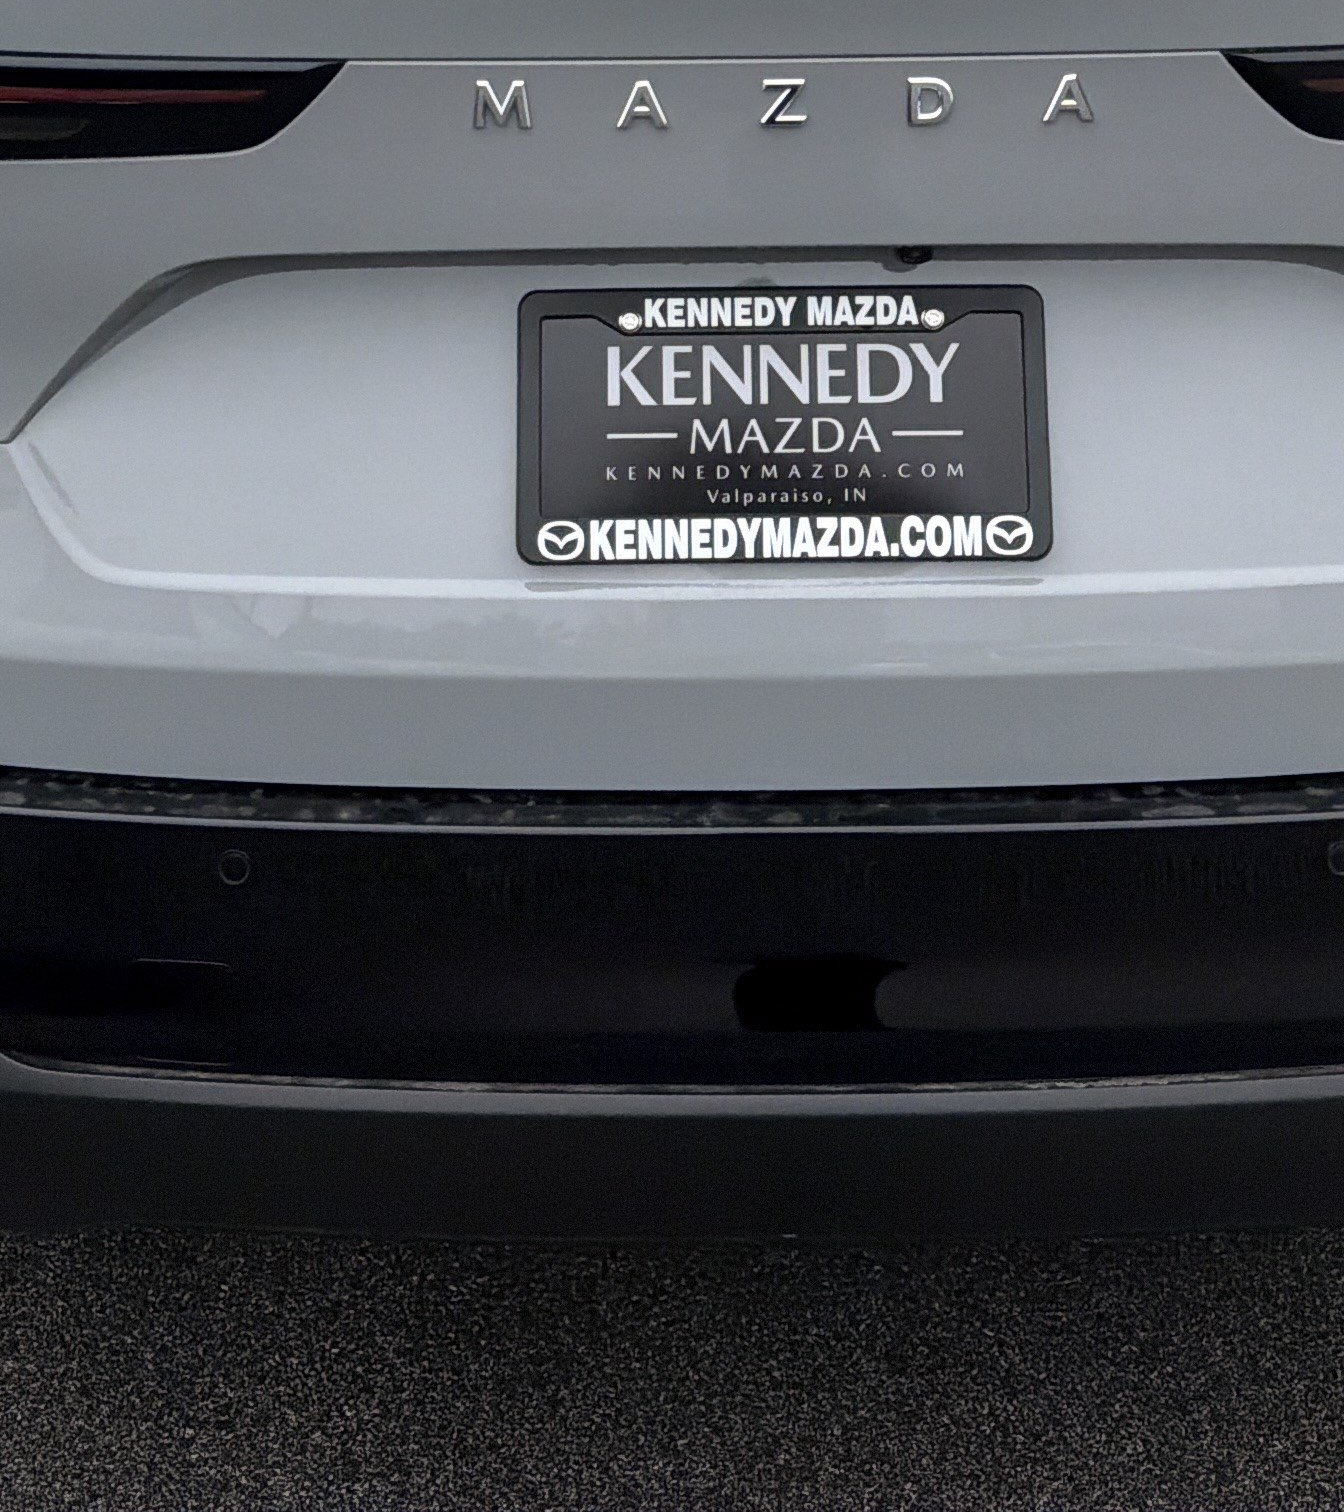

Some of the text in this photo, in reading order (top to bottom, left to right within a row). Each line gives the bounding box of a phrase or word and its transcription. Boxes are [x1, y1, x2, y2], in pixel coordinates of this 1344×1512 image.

[472, 73, 1094, 130] MAZDA
[644, 295, 920, 328] KENNEDY MAZDA
[607, 342, 960, 407] KENNEDY
[689, 417, 882, 455] MAZDA
[606, 462, 965, 481] KENNEDYMAZDA.COM
[707, 487, 868, 507] Valparaiso, IN
[590, 515, 984, 561] KENNEDYMAZDA.COM
